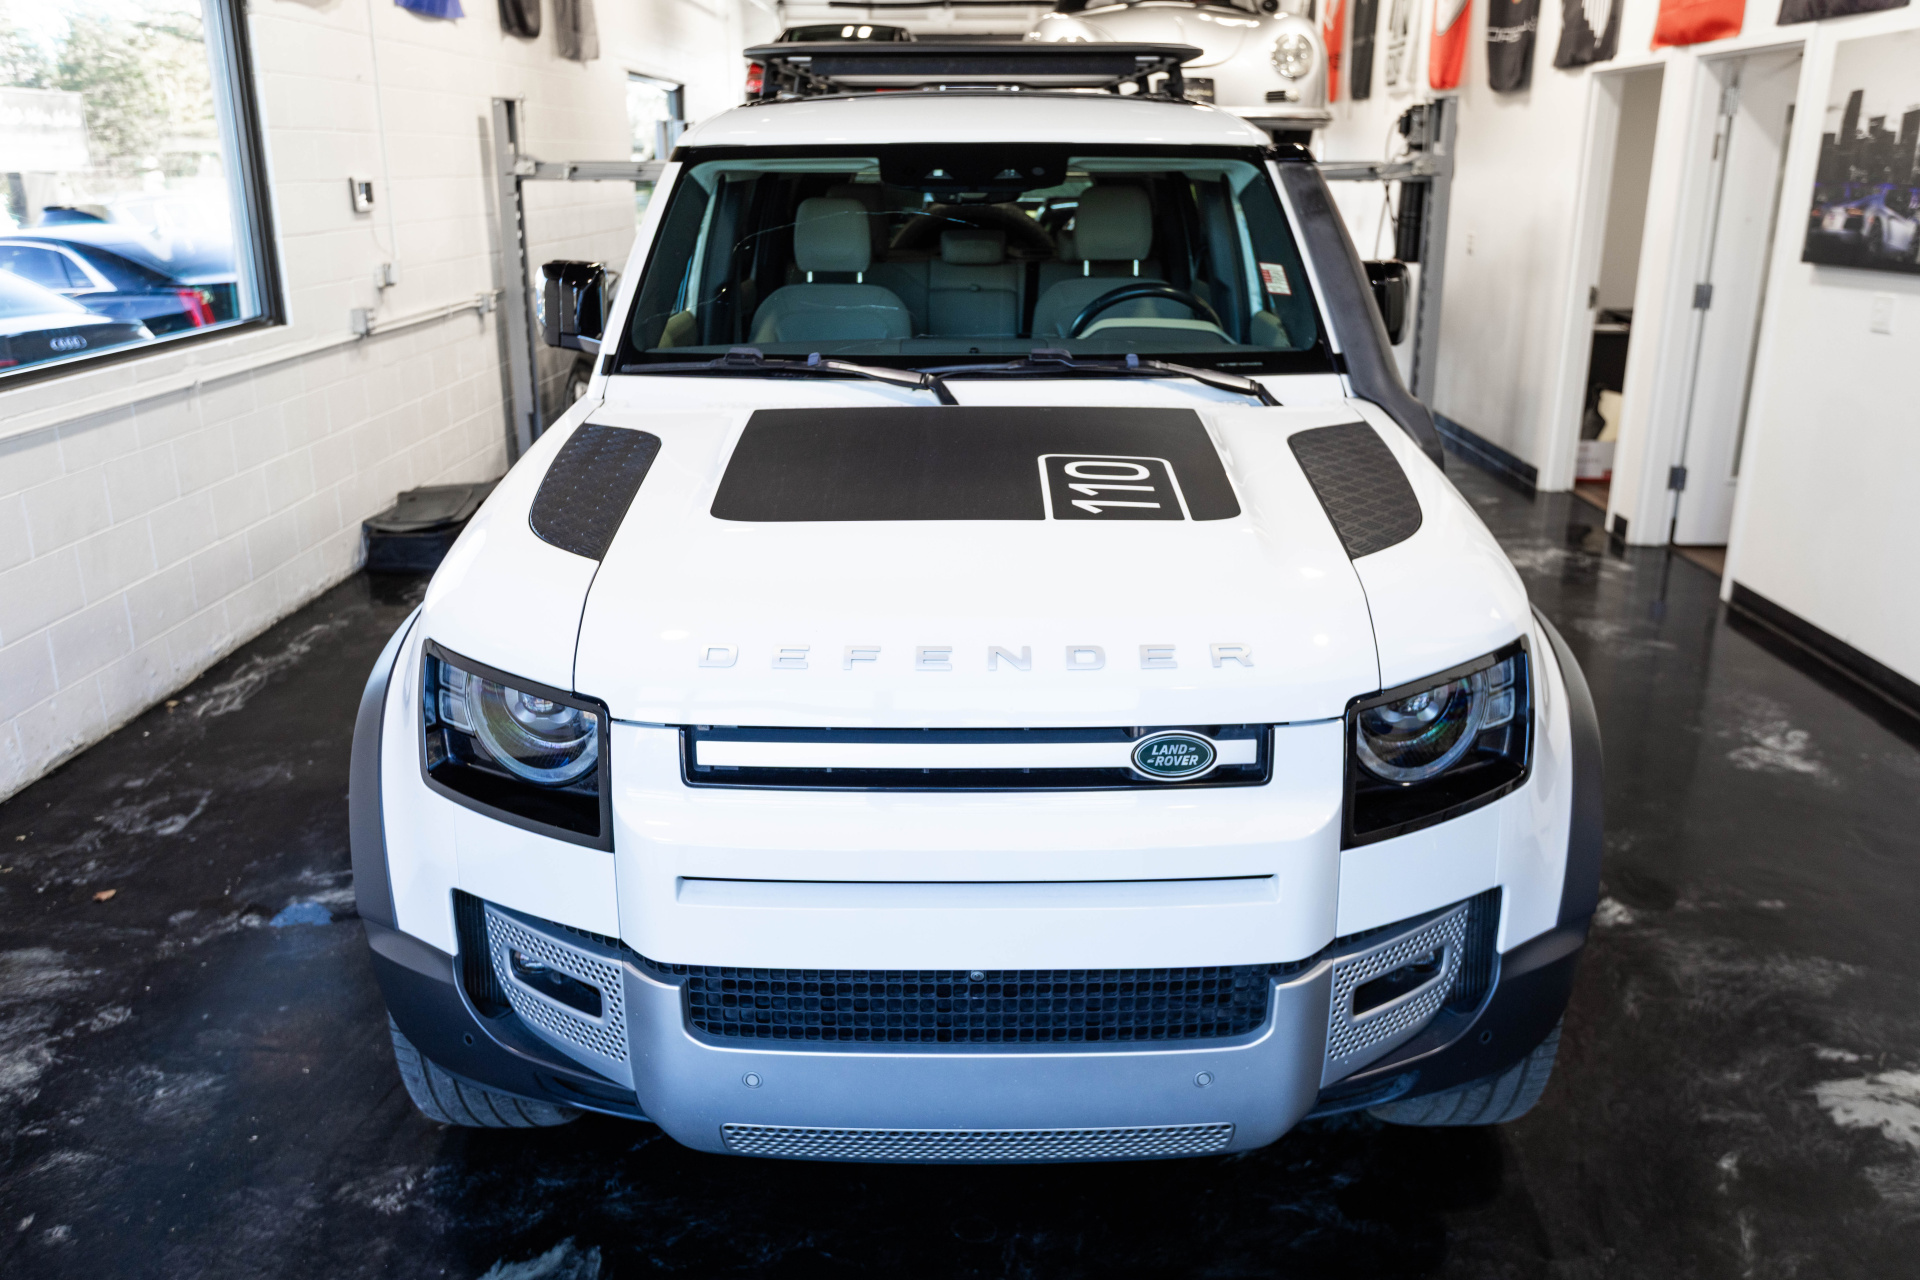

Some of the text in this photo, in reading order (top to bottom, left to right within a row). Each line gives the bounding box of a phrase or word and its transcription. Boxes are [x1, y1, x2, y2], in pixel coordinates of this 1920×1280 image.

[1064, 461, 1161, 514] 110
[699, 643, 1254, 672] DEFENDER
[1151, 744, 1188, 756] LAND
[1154, 754, 1199, 767] ROVER
